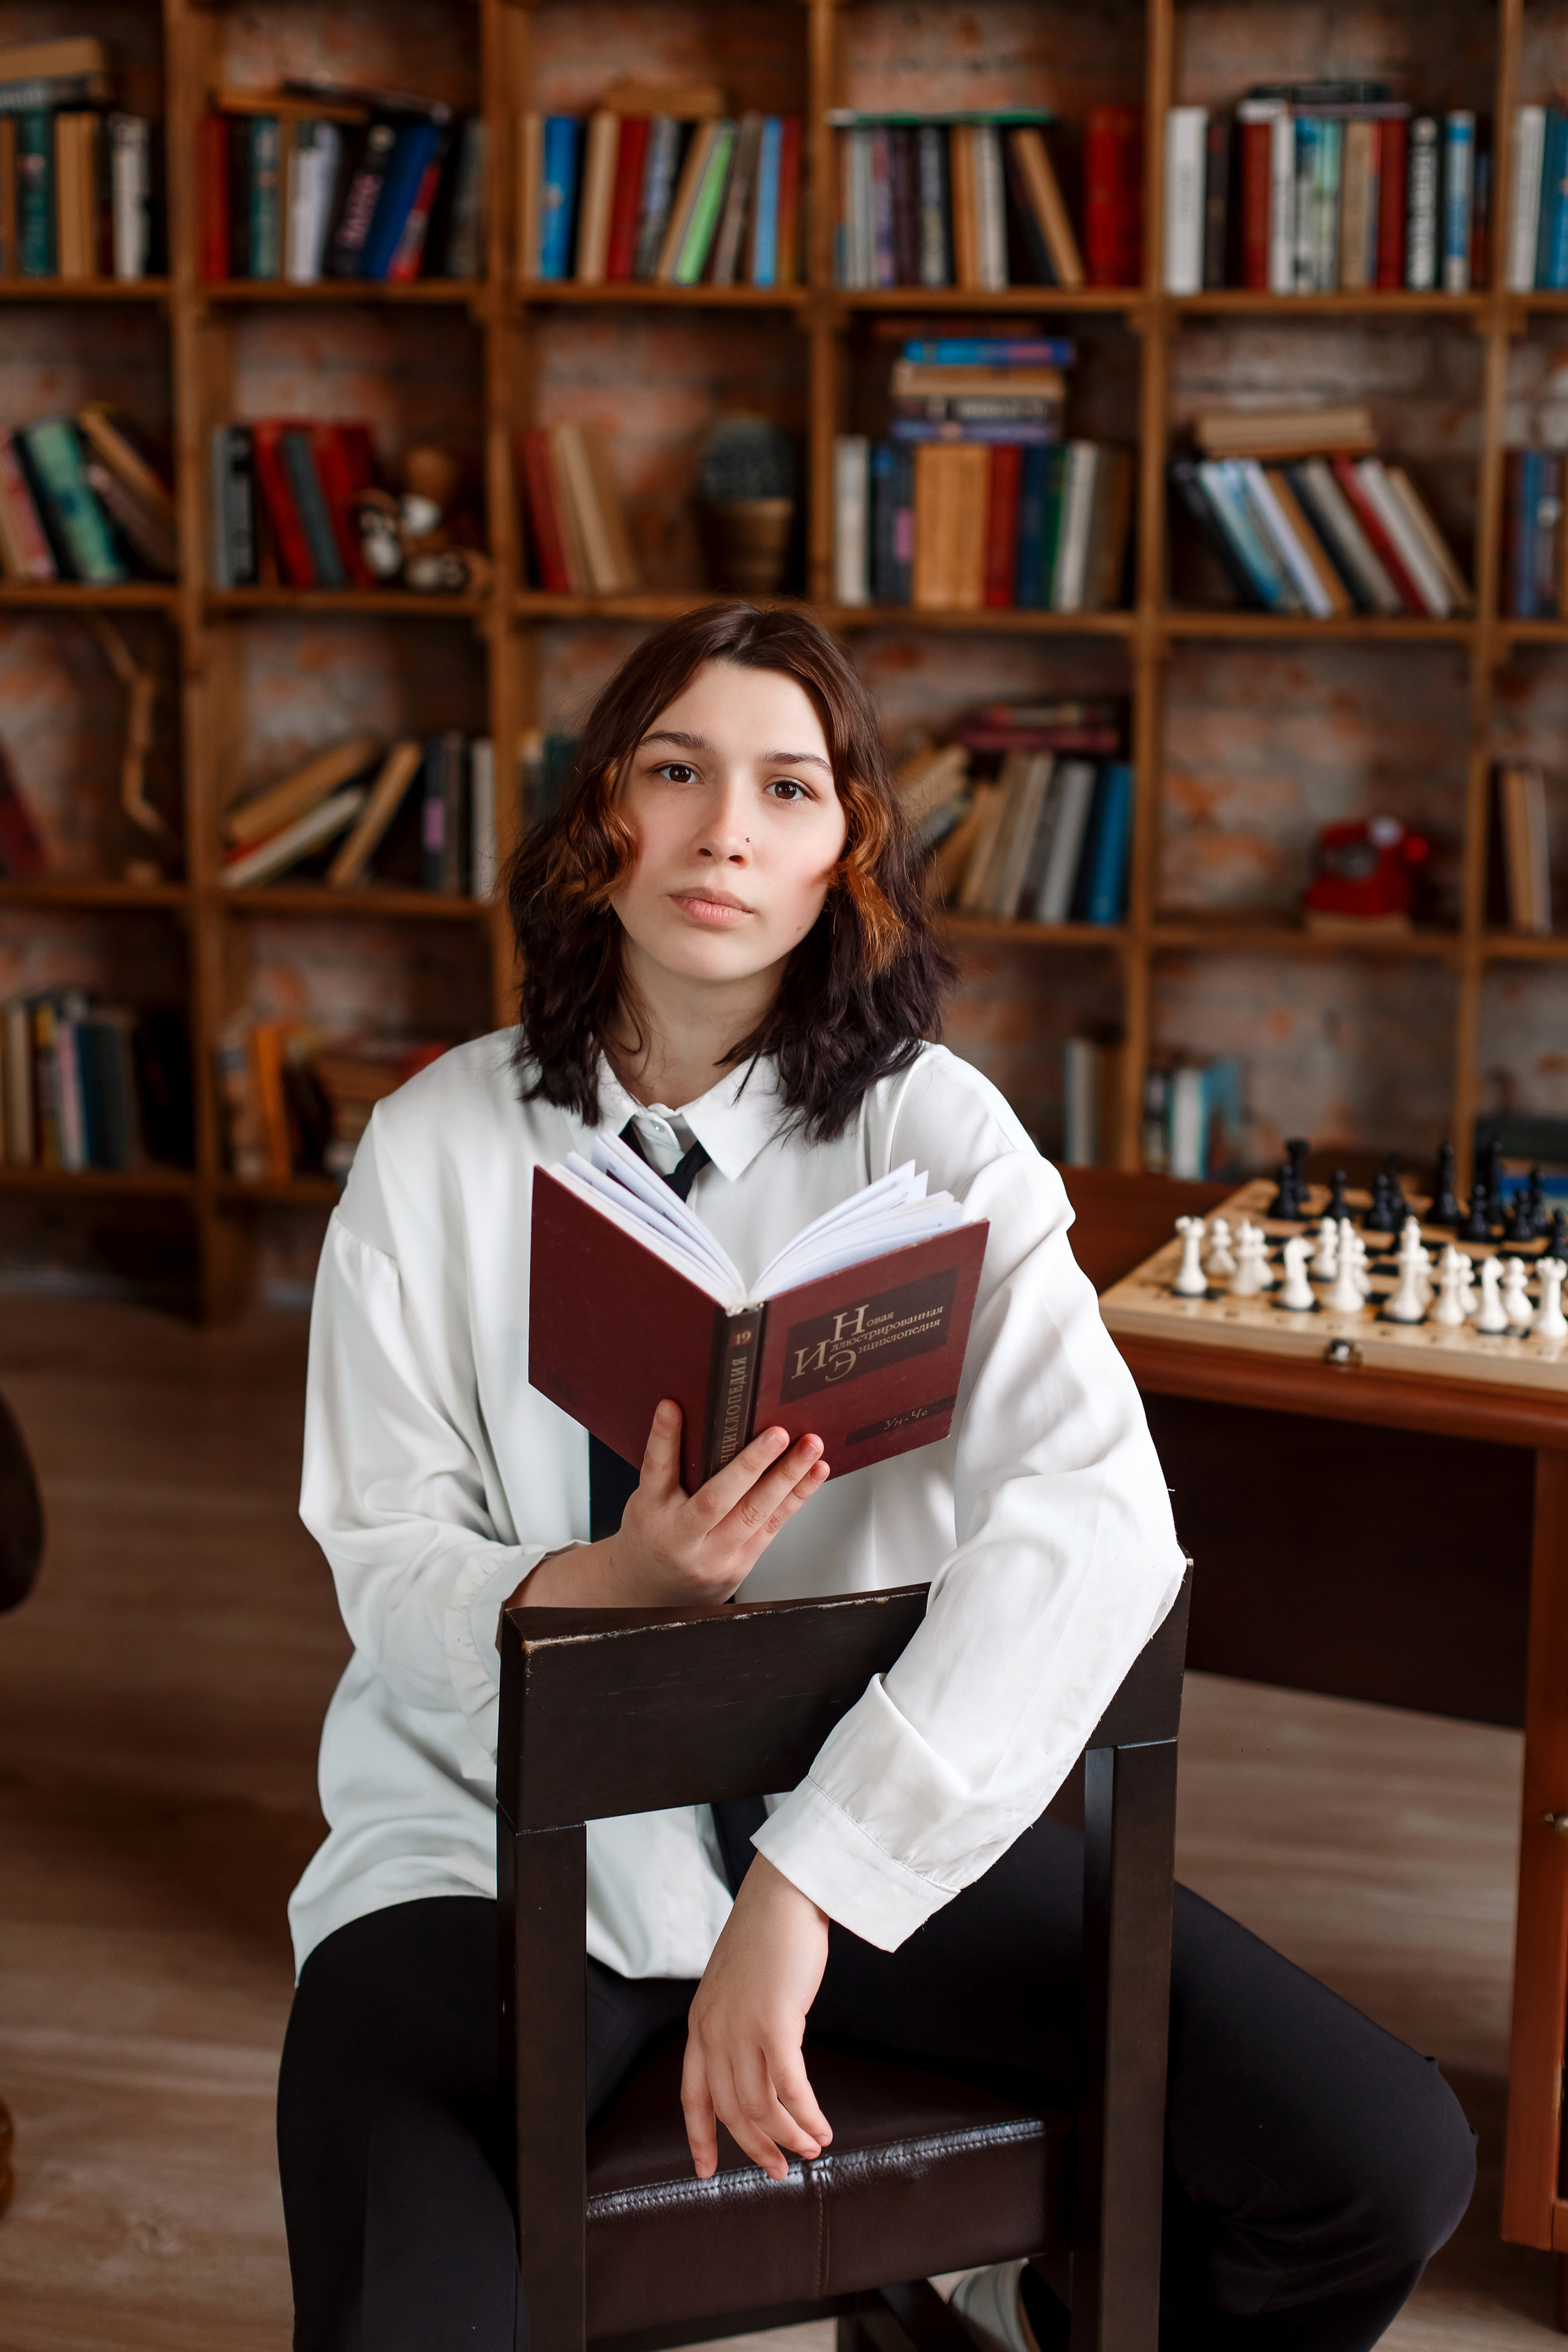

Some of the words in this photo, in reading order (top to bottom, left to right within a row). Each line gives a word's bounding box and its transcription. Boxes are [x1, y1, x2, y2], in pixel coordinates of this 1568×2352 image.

[735, 1330, 752, 1346] 19
[791, 1305, 944, 1379] Иллюстрированная
[824, 1318, 941, 1382] Энциклопедия
[829, 1303, 894, 1344] Новая
[720, 1355, 747, 1469] НЦИКЛОПЕДИЯ
